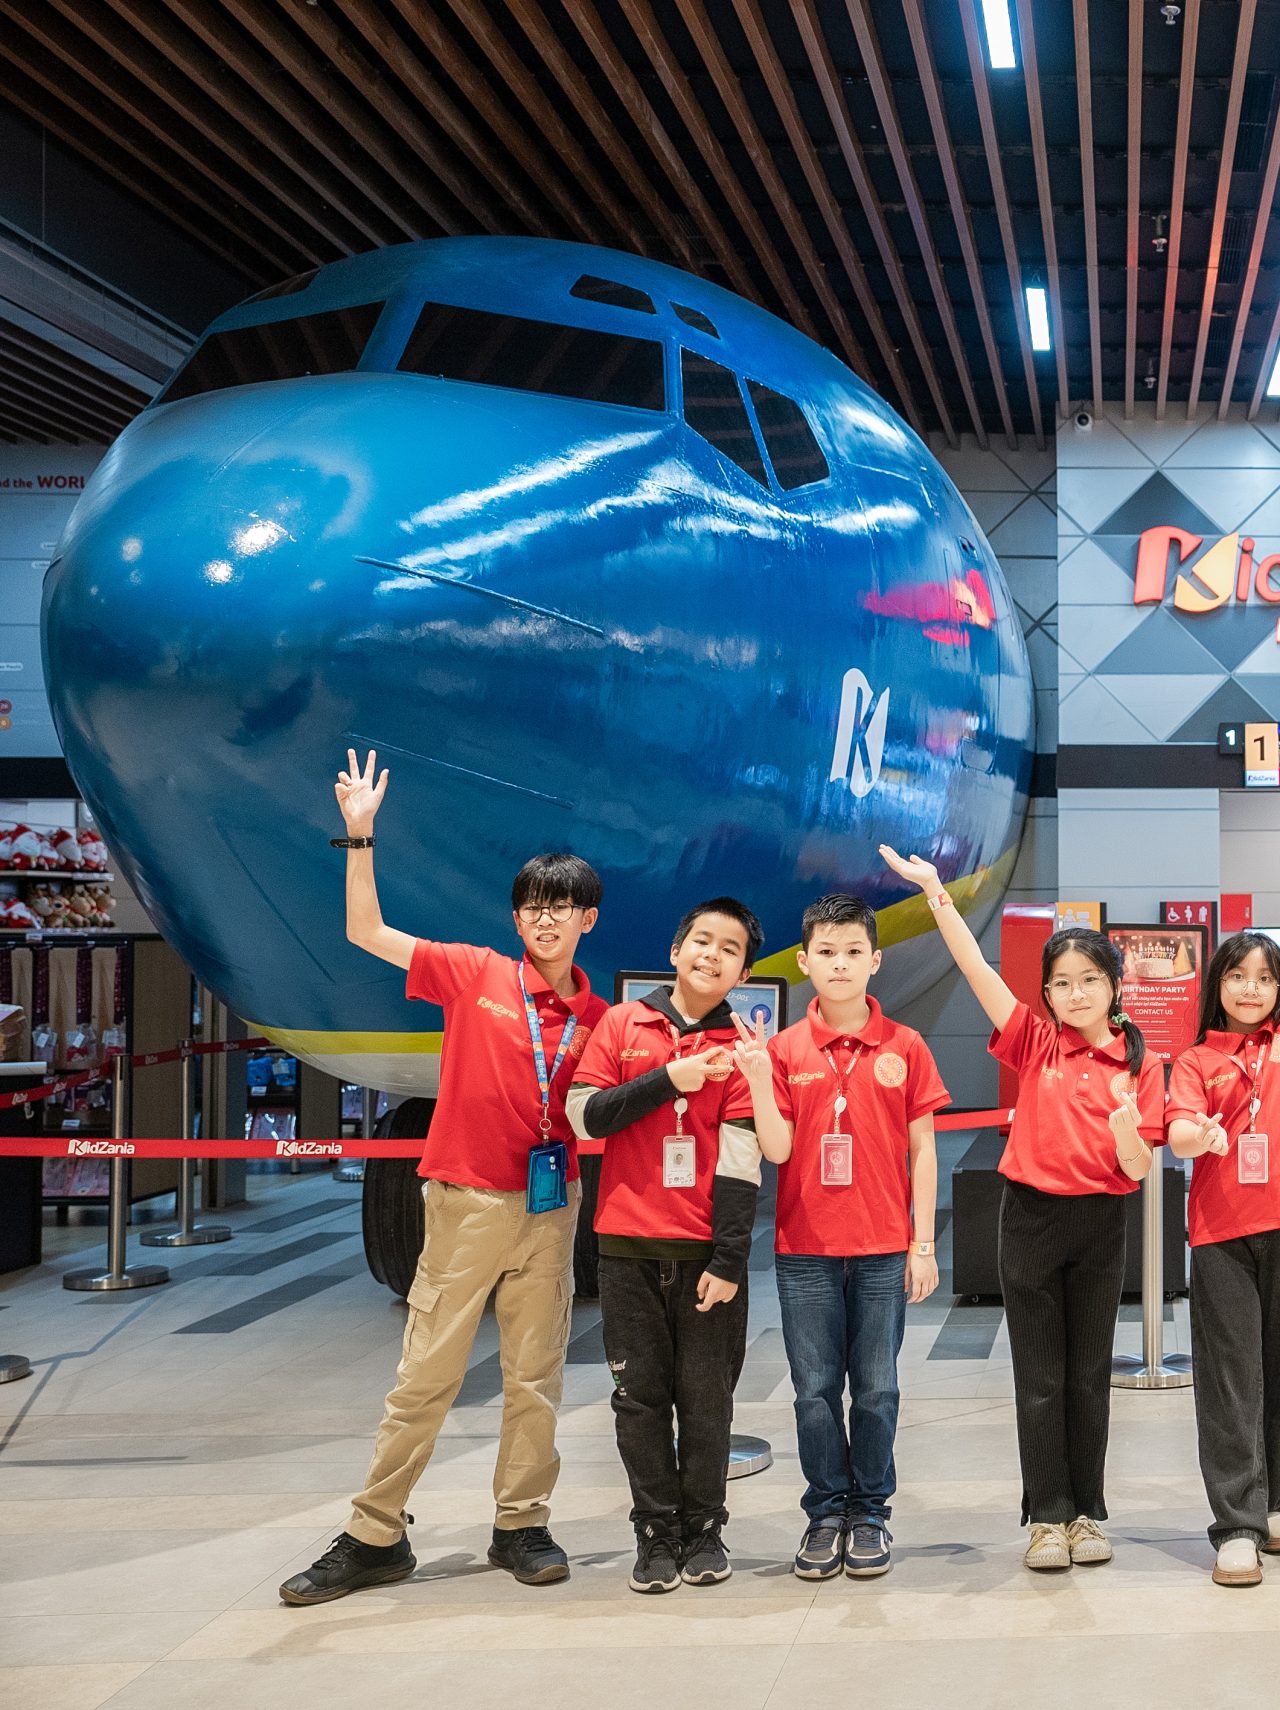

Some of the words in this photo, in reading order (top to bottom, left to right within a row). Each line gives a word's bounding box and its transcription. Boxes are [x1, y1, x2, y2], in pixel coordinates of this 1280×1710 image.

[13, 479, 32, 488] the
[37, 475, 85, 488] WORL
[1225, 729, 1236, 746] 1
[1253, 735, 1265, 761] 1
[477, 996, 519, 1020] KidZania
[788, 1072, 824, 1084] KidZania
[67, 1139, 135, 1156] KidZania
[276, 1139, 342, 1156] KidZania
